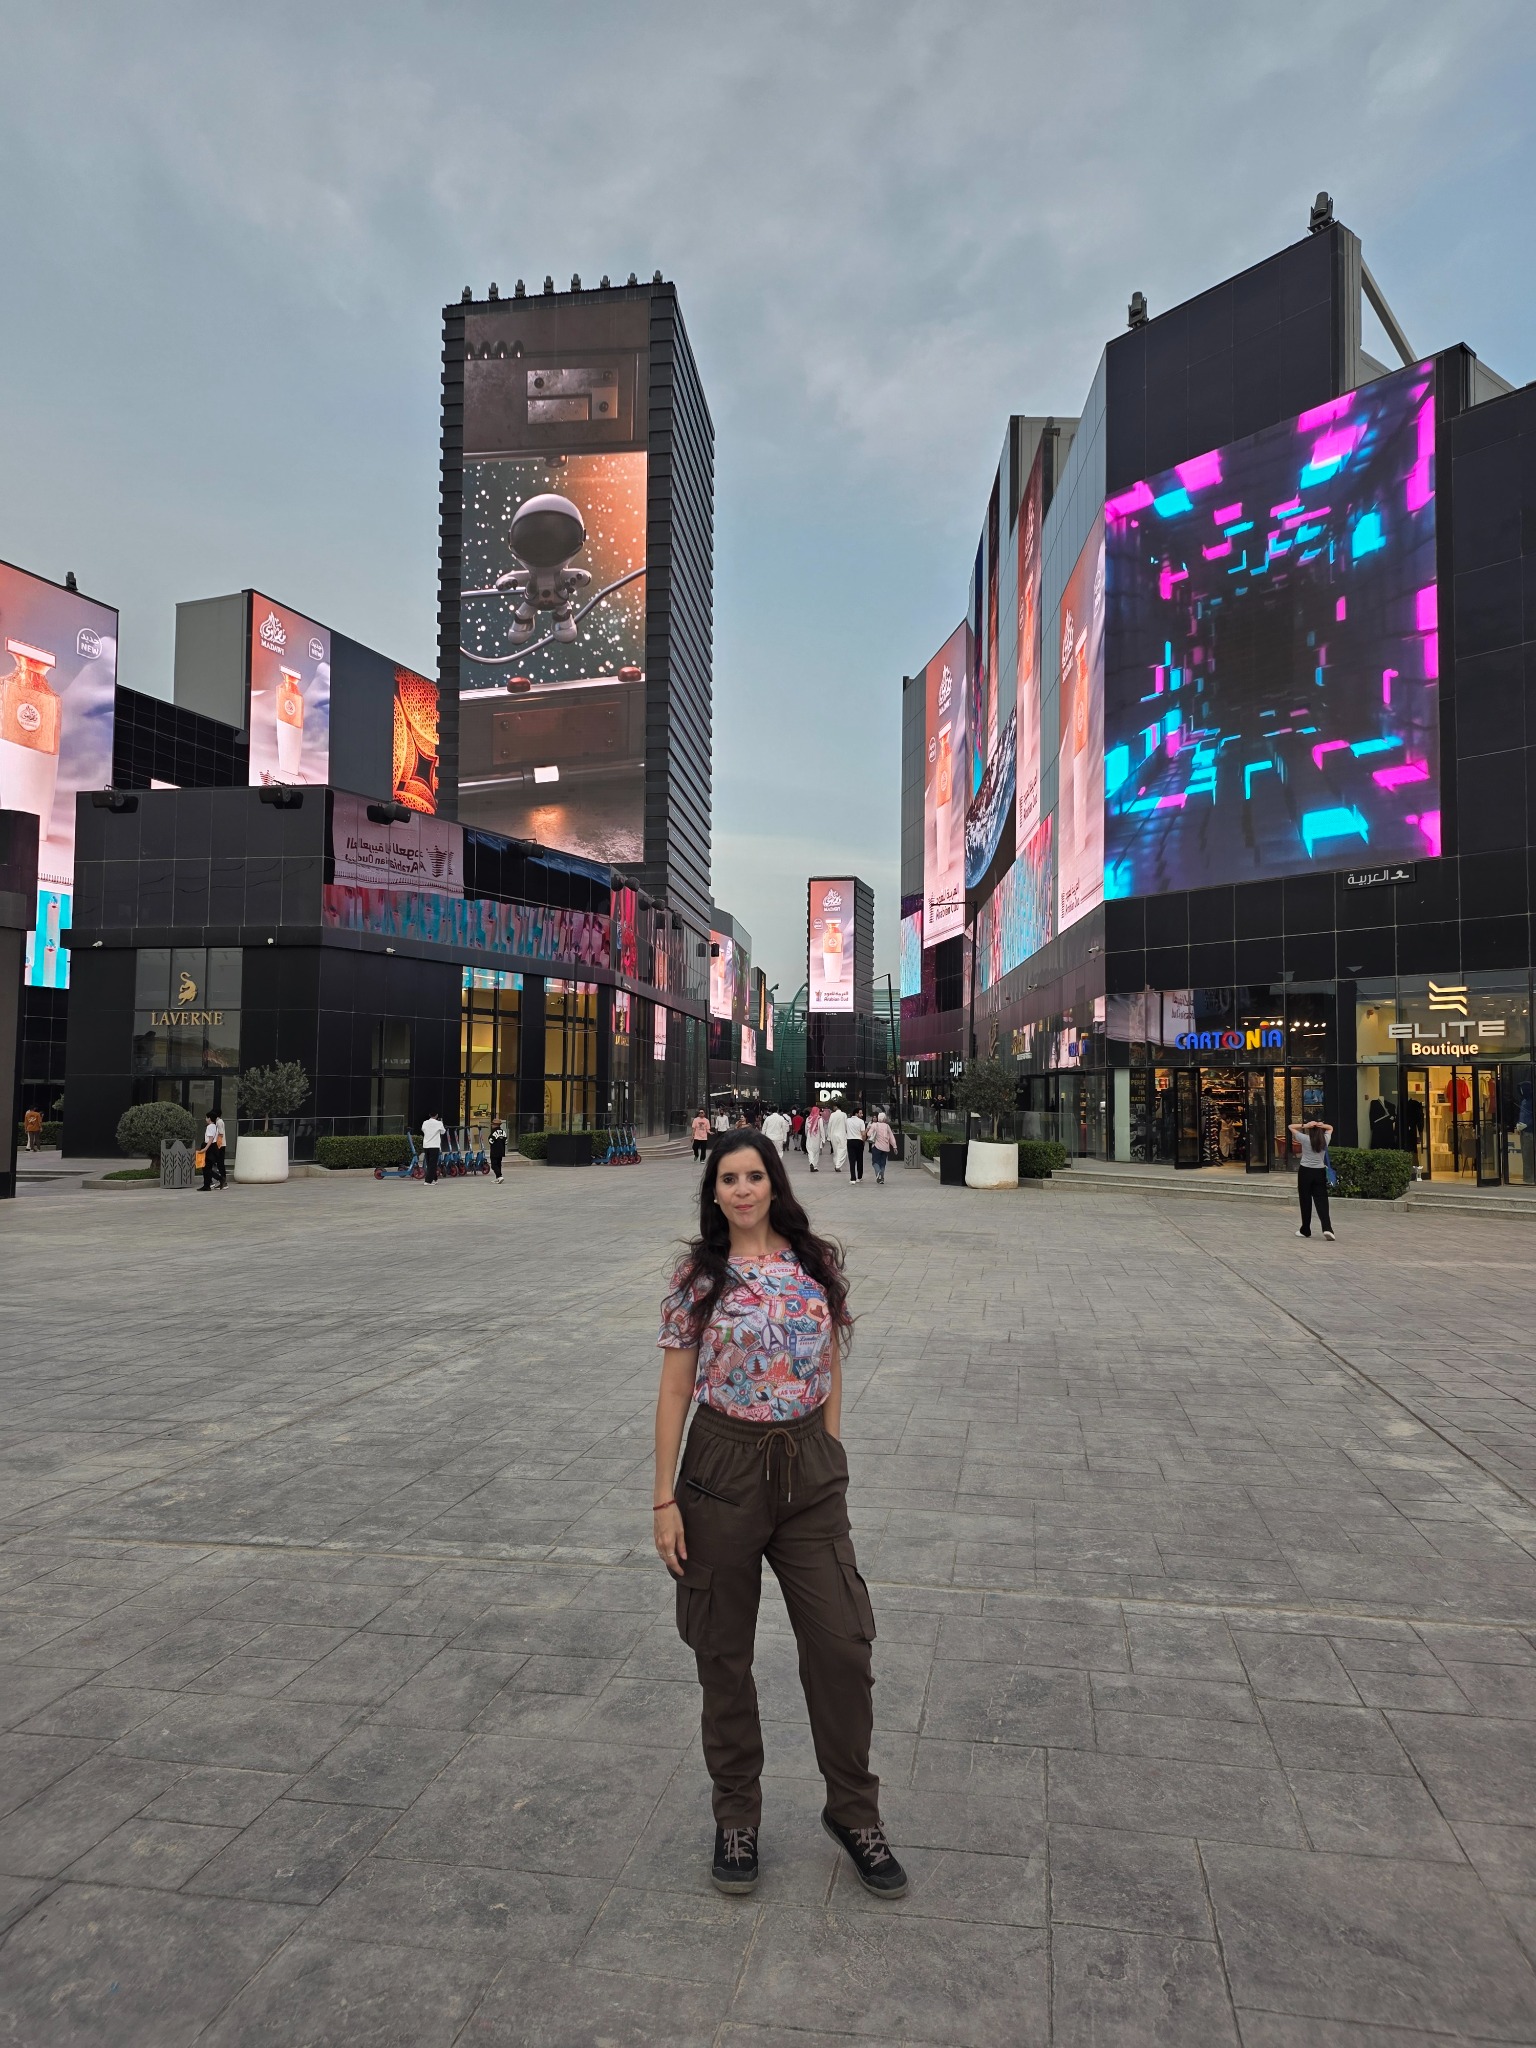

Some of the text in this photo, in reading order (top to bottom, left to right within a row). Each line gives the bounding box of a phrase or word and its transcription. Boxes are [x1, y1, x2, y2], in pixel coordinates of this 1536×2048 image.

[81, 643, 99, 655] NEW
[261, 639, 285, 656] MADAWI
[1347, 869, 1389, 886] العربية
[151, 1011, 224, 1026] LAVERNE
[1174, 1021, 1283, 1051] CARTOONIA
[1388, 1020, 1506, 1039] ELITE
[1411, 1041, 1479, 1058] Boutique
[905, 1061, 920, 1078] DZRT
[814, 1081, 848, 1089] DUNKIN'
